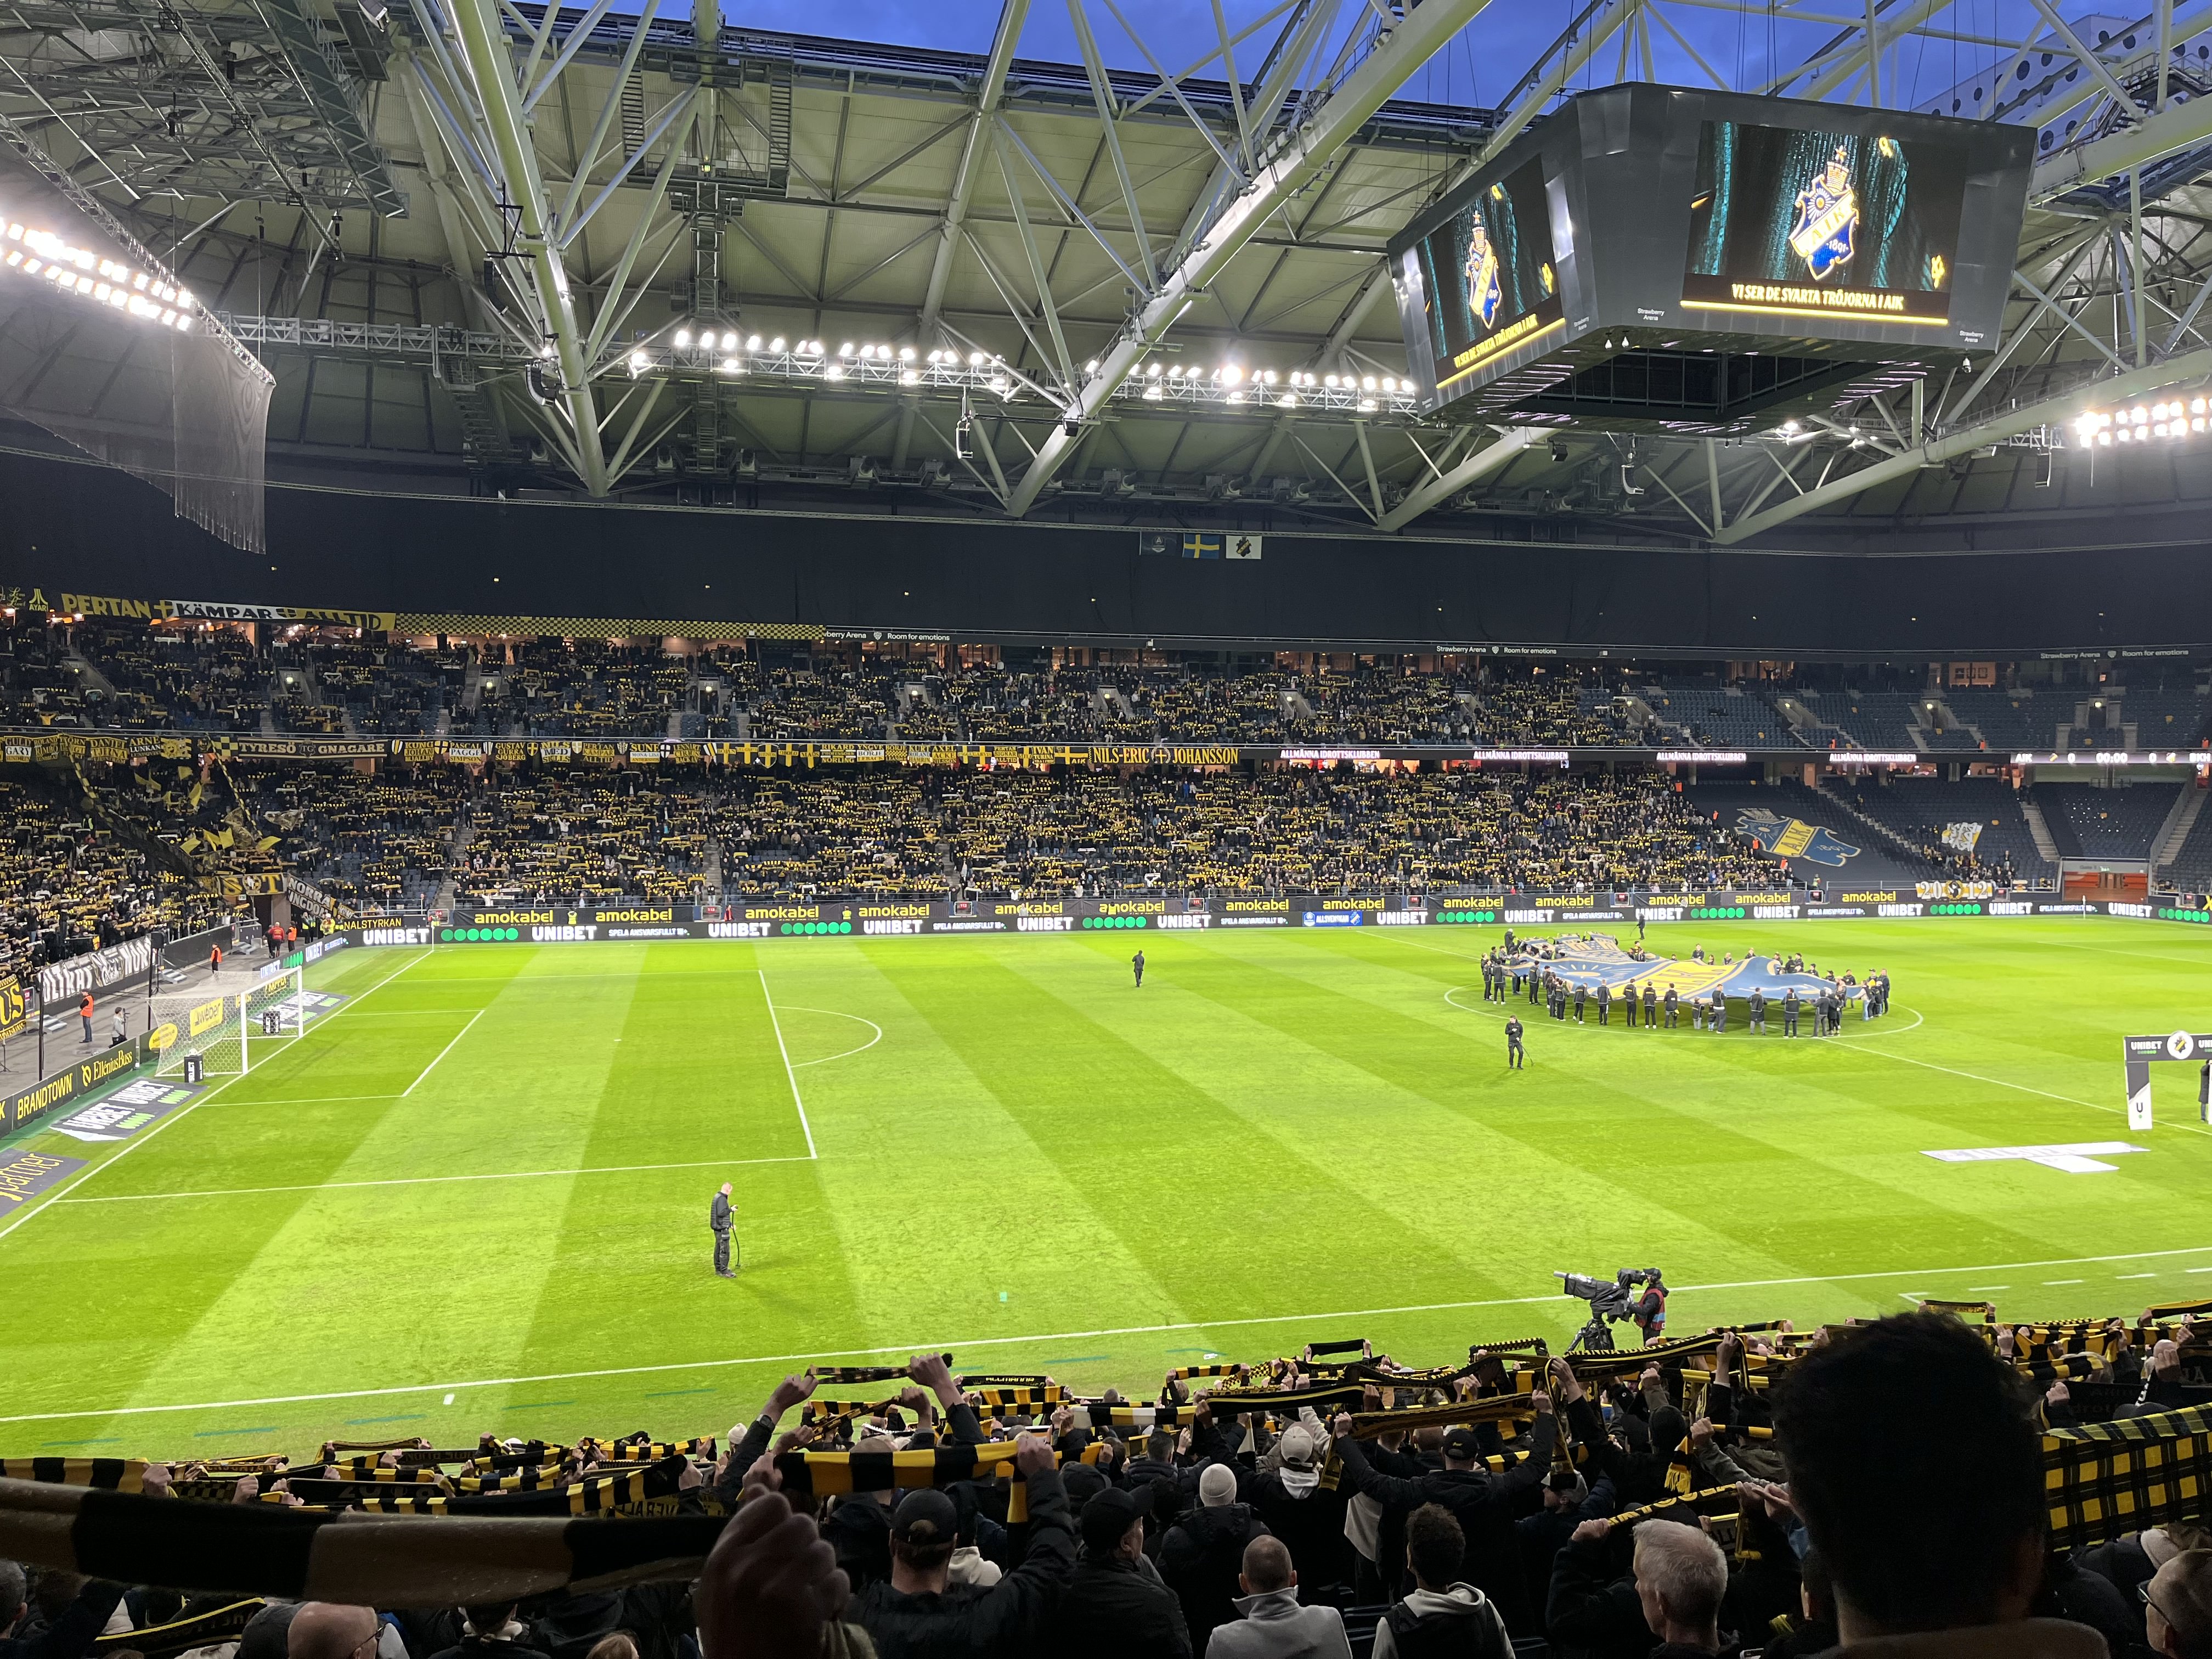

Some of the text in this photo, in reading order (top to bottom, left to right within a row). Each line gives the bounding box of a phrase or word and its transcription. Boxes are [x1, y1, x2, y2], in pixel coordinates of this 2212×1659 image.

[1732, 284, 1743, 299] VI
[1745, 285, 1764, 300] SER
[1766, 286, 1781, 302] DE
[1782, 287, 1820, 305] SVARTA
[1822, 289, 1876, 308] TRÖJORNA
[1884, 296, 1904, 310] AIK
[1637, 308, 1665, 317] Strawberry
[61, 593, 381, 630] PERTAN KÄMPAR ALLTID
[91, 740, 126, 749] DANIEL
[129, 736, 161, 746] ARNE
[631, 743, 660, 752] SUNE
[130, 744, 161, 753] LUNKAN
[239, 742, 296, 754] TYRESÖ
[318, 743, 385, 754] GNAGARE
[1280, 749, 1380, 759] ALLMÄNNA IDROTTSKLUBBEN
[1093, 747, 1239, 764] NILS-ERIC JOHANSSON
[1473, 750, 1568, 760] ALLMÄNNA IDROTTSKLUBBEN
[1657, 752, 1746, 761] ALLMÄNNA IDROTTSKLUBBEN
[1829, 752, 1916, 762] ALLMÄNNA IDROTTSKLUBBEN
[2015, 753, 2033, 763] AIK
[2068, 753, 2075, 763] 0
[2096, 753, 2128, 763] 00:00
[2148, 753, 2157, 763] 0
[289, 877, 331, 909] NORRA
[1842, 890, 1896, 902] amokabel
[1921, 881, 1988, 899] 20 12
[1323, 898, 1385, 910] amokabel
[1443, 896, 1503, 908] amokabel
[1536, 895, 1594, 906] amokabel
[1735, 892, 1791, 904] amokabel
[859, 904, 929, 917] amokabel
[1226, 899, 1289, 911] amokabel
[1878, 904, 1923, 916] UNIBET
[1989, 902, 2033, 915] UNIBET
[2109, 902, 2152, 917] UNIBET
[475, 910, 553, 924] amokabel
[595, 908, 672, 922] amokabel
[745, 906, 819, 919] amokabel
[1376, 911, 1428, 924] UNIBET
[1504, 910, 1554, 922] UNIBET
[1635, 907, 1684, 920] UNIBET
[1754, 906, 1800, 918] UNIBET
[1017, 916, 1073, 930] UNIBET
[1158, 914, 1211, 928] UNIBET
[1316, 915, 1349, 923] ALLSVENSKAN
[532, 926, 597, 940] UNIBET
[708, 923, 770, 937] UNIBET
[863, 920, 923, 934] UNIBET
[363, 928, 429, 945] UNIBET
[306, 941, 323, 962] UNIBET
[2131, 1041, 2162, 1050] UNIBET
[17, 1073, 74, 1120] BRANDTOWN
[108, 1080, 174, 1104] UNIBET
[62, 1102, 136, 1130] UNIBET
